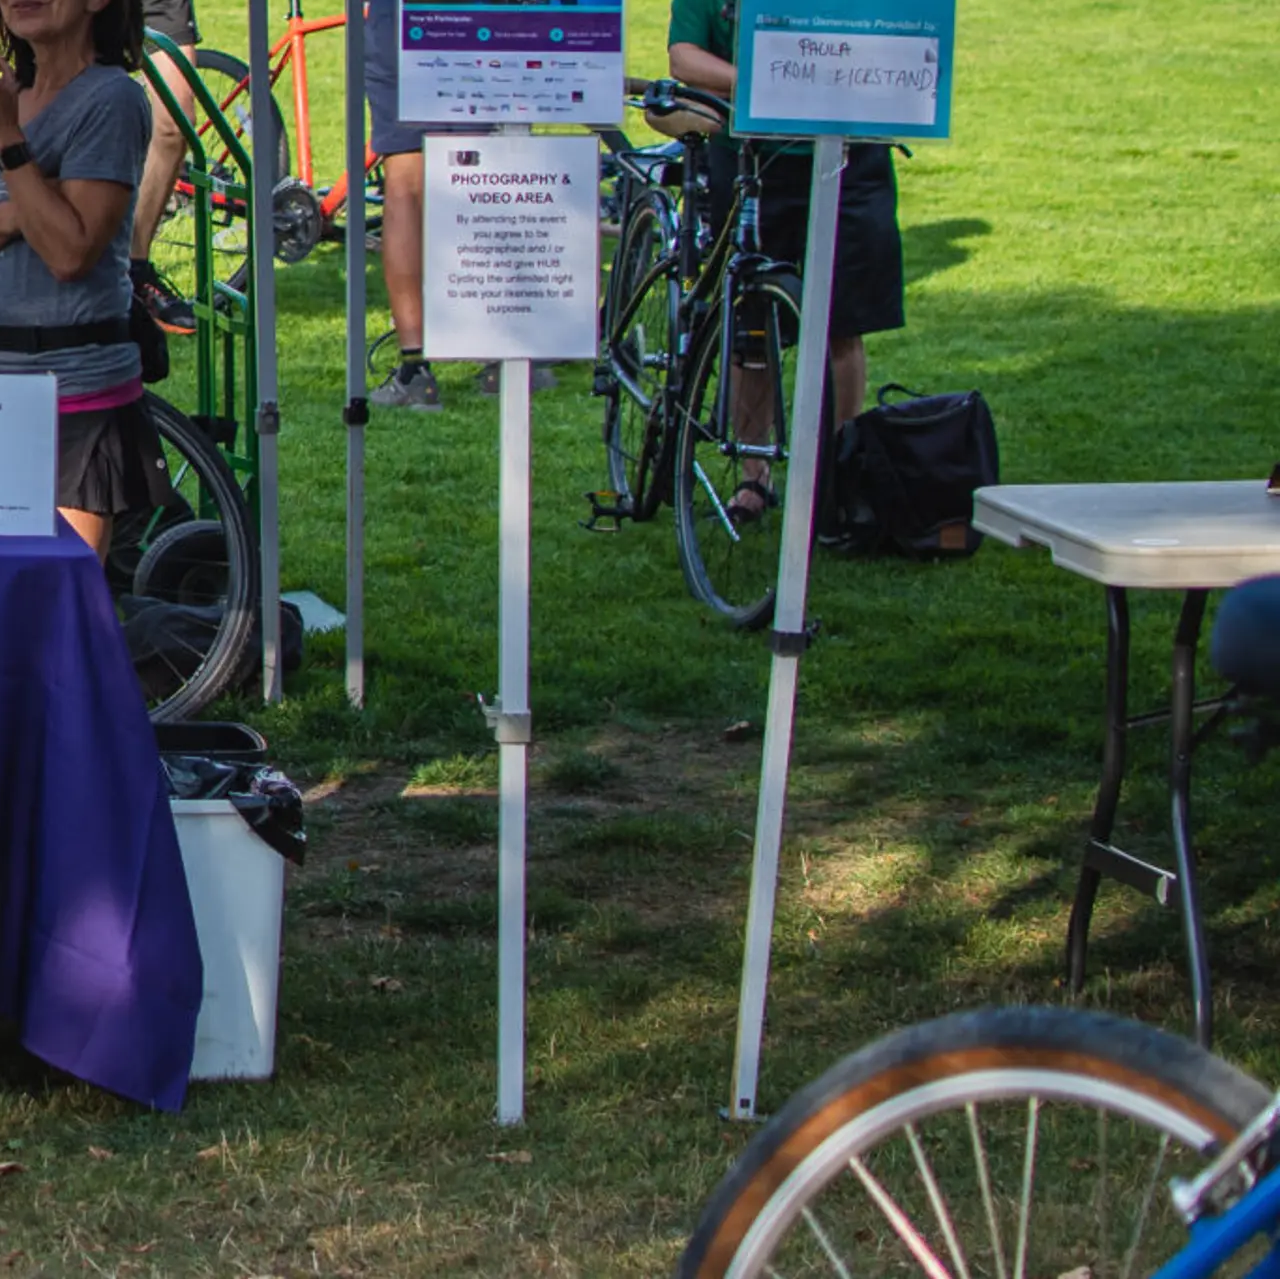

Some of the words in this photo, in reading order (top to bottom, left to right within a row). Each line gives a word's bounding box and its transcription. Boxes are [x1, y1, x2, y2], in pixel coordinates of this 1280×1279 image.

[798, 38, 851, 57] PAULA
[770, 60, 816, 84] FROM
[451, 173, 558, 186] PHOTOGRAPHY
[562, 173, 571, 186] &
[469, 192, 512, 204] VIDEO
[515, 192, 554, 204] AREA
[456, 214, 469, 224] By
[472, 214, 517, 225] attending
[519, 214, 537, 224] this
[539, 215, 567, 223] event
[473, 231, 491, 240] you
[494, 231, 522, 240] agree
[525, 230, 533, 238] to
[536, 229, 549, 238] be
[457, 244, 525, 255] photographed
[527, 244, 546, 253] and
[554, 245, 565, 253] or
[461, 258, 491, 268] filmed
[493, 259, 512, 268] and
[514, 259, 536, 269] give
[448, 273, 484, 284] Cycling
[487, 273, 503, 283] the
[505, 273, 549, 283] unlimited
[551, 273, 573, 284] right
[448, 289, 458, 298] to
[460, 290, 478, 298] use
[480, 290, 502, 300] your
[546, 289, 559, 298] for
[562, 289, 573, 298] all
